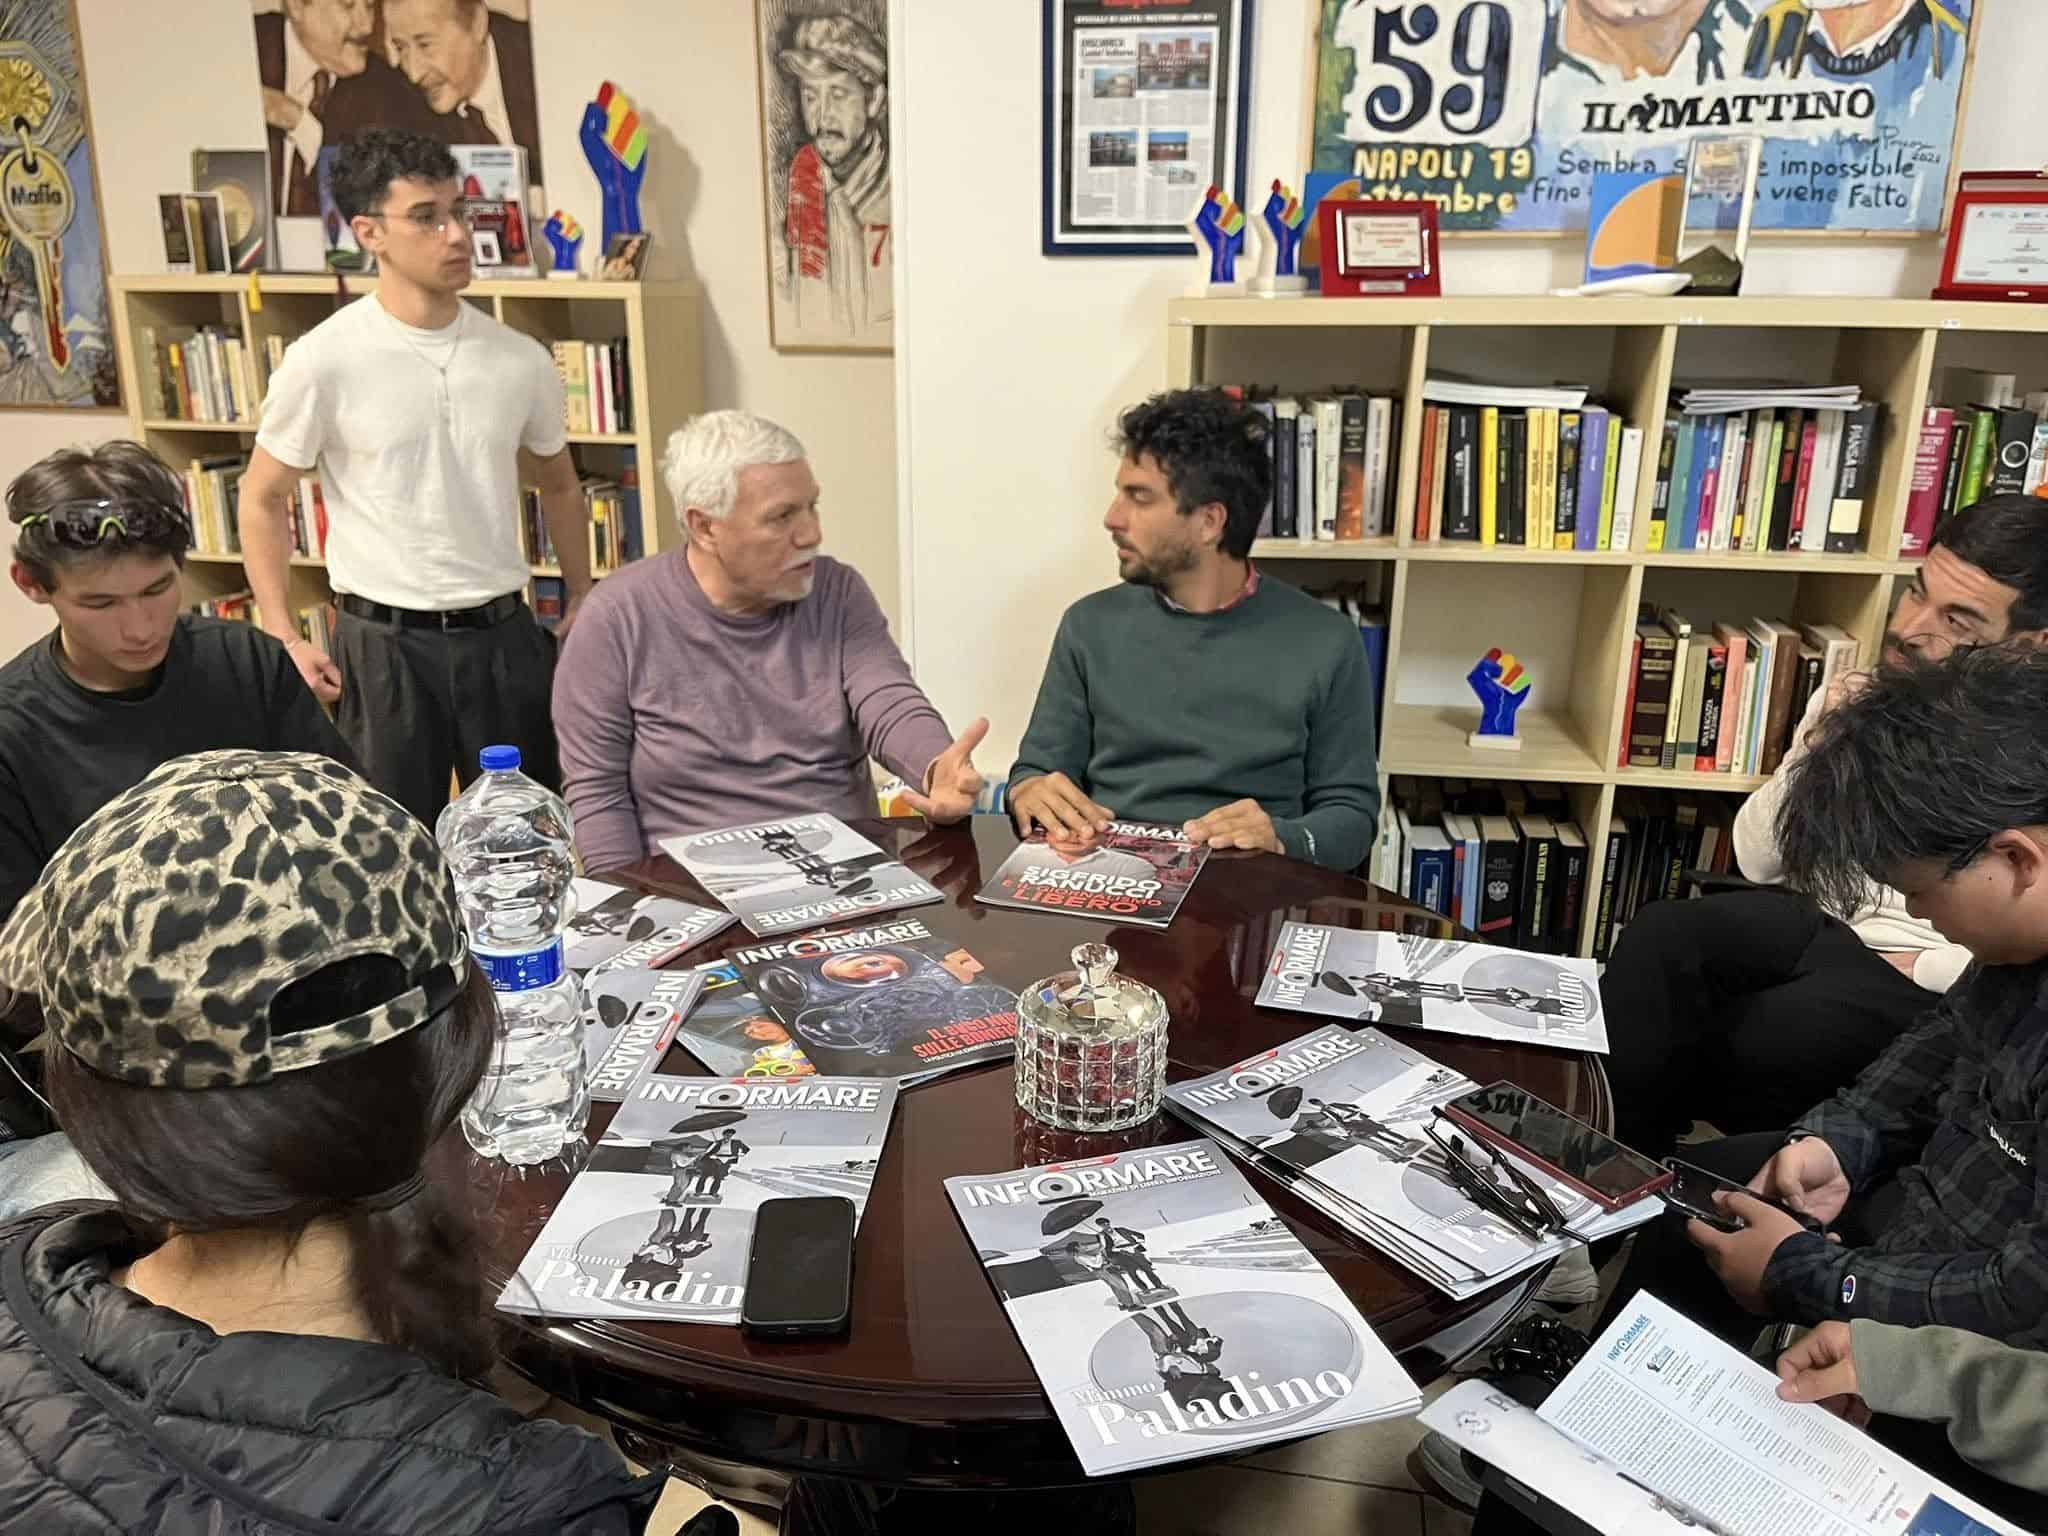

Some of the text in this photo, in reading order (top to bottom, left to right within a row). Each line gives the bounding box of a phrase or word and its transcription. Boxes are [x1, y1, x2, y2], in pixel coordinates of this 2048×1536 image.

[1365, 2, 1512, 134] 59
[1581, 88, 1876, 132] IL MATTINO
[1353, 146, 1533, 181] NAPOLI 19
[1557, 149, 1656, 174] Sembra
[1780, 149, 1916, 184] impossibile
[11, 183, 63, 207] Mafia
[1771, 185, 1840, 204] viene
[694, 817, 833, 847] Paladino
[1019, 875, 1155, 899] RANUCCI
[1023, 865, 1162, 890] SIGFRIDO
[753, 882, 932, 927] INFORMARE
[1012, 889, 1138, 914] LIBERO
[1037, 886, 1162, 907] GIORNALISMO
[736, 922, 933, 965] INFORMARE
[1273, 927, 1323, 1006] INFORMARE
[1545, 972, 1588, 1042] Paladino
[591, 971, 690, 1090] INFORMARE
[912, 1037, 960, 1059] SULLE
[1183, 1032, 1361, 1108] INFORMARE
[639, 1083, 882, 1109] INFORMARE
[962, 1151, 1218, 1207] INFORMARE
[549, 1246, 623, 1267] Mimmo
[532, 1258, 744, 1308] Paladin
[1607, 1313, 1651, 1362] INFORMARE
[1071, 1382, 1156, 1404] Mimmo
[1084, 1370, 1353, 1446] Paladino
